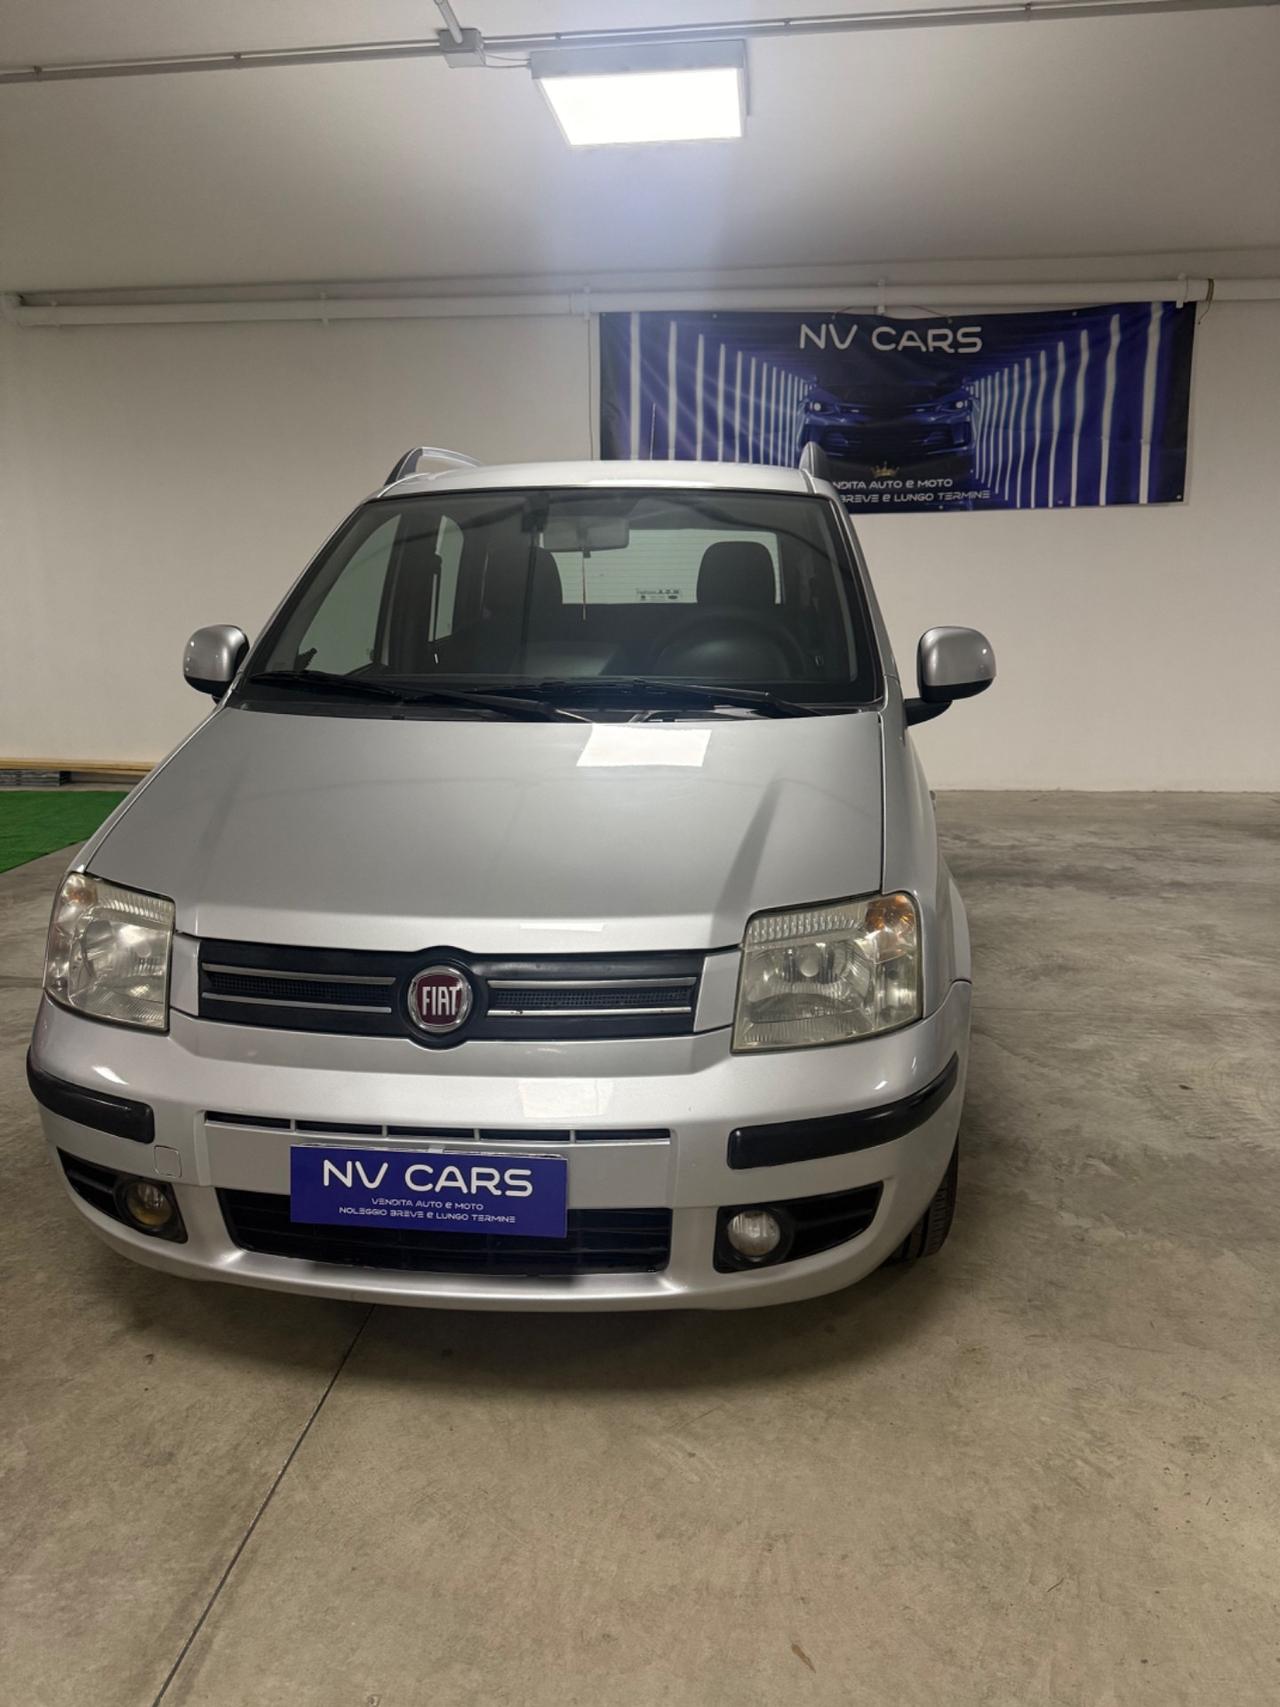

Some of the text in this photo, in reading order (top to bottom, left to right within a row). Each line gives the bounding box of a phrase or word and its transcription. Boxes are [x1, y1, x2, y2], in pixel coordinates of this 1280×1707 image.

[800, 323, 983, 353] NV CARS
[832, 481, 866, 489] NDITA
[869, 480, 903, 489] AUTO
[917, 478, 953, 488] MOTO
[894, 492, 934, 502] LUNGO
[938, 490, 990, 500] TERMINE
[422, 986, 460, 1016] FIAT
[323, 1159, 533, 1197] NV CARS
[371, 1198, 413, 1206] VENDITA
[415, 1200, 443, 1208] AUTO
[454, 1202, 484, 1211] MOTO
[339, 1207, 387, 1216] NOLEGGIO
[390, 1209, 424, 1218] BREVE
[436, 1212, 469, 1221] LUNGO
[471, 1214, 516, 1223] TERMINE
